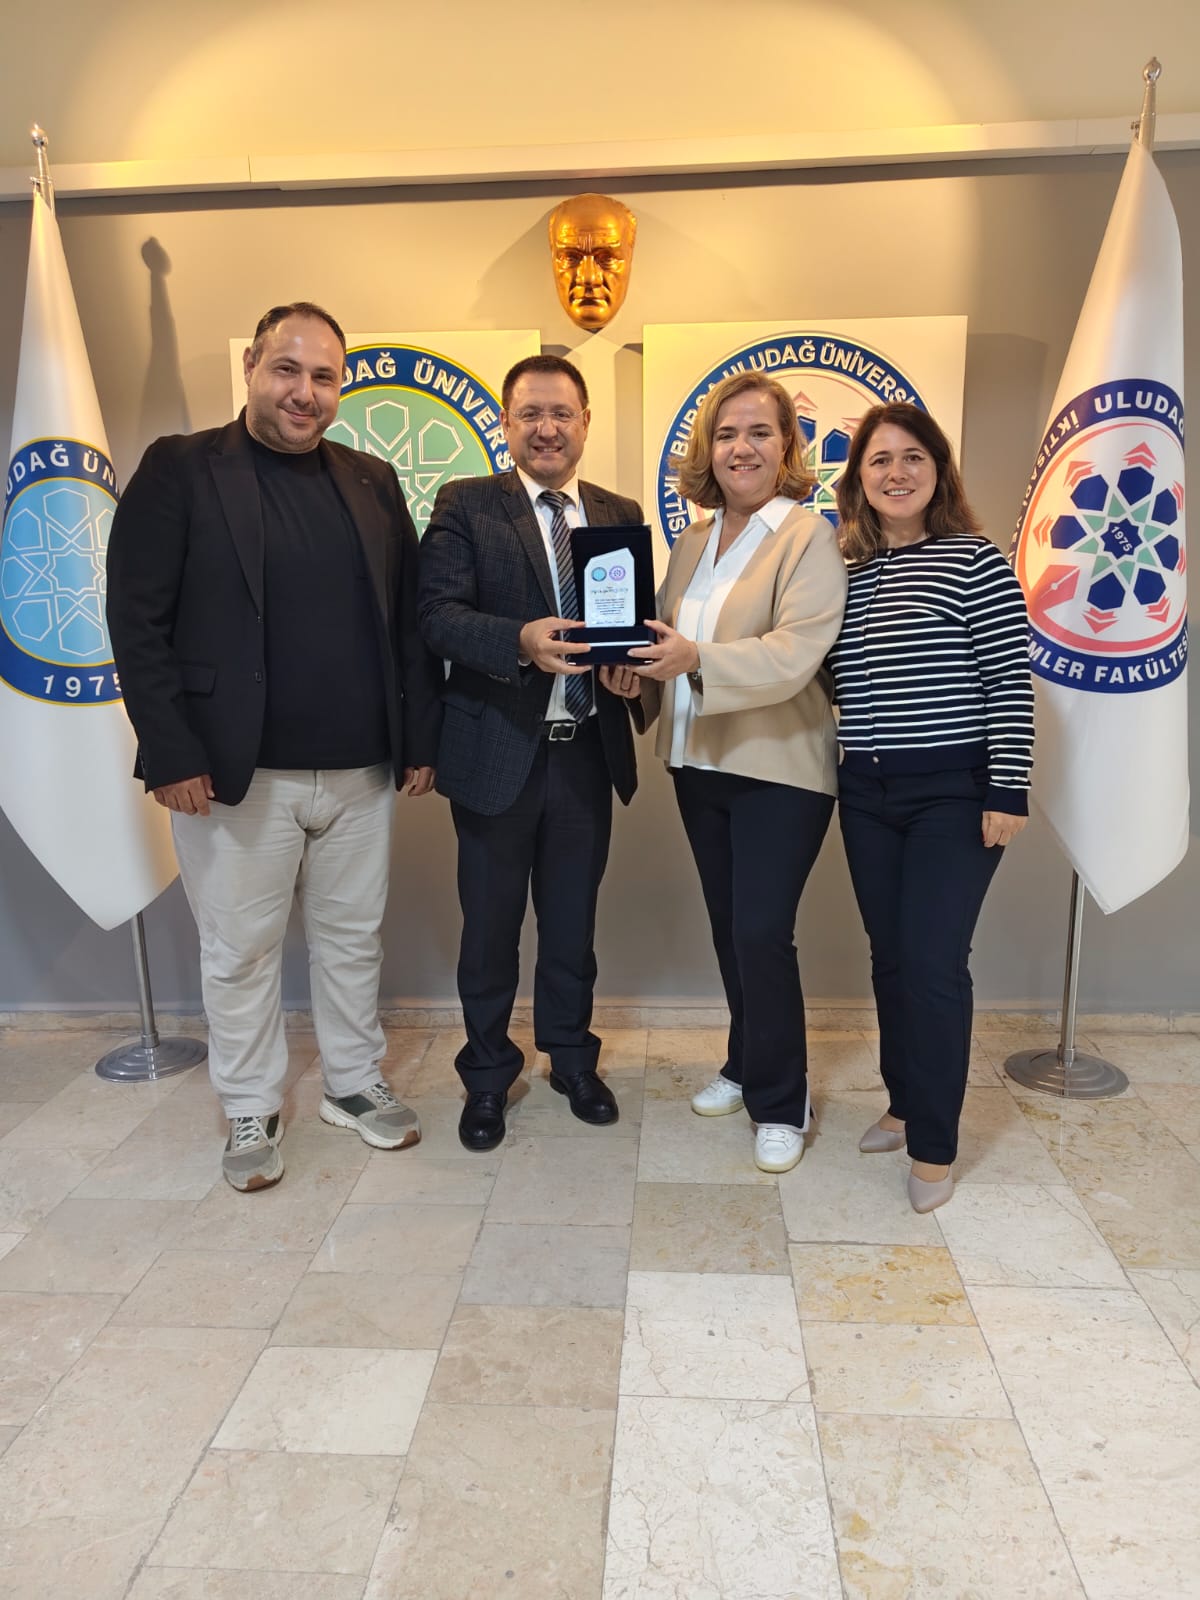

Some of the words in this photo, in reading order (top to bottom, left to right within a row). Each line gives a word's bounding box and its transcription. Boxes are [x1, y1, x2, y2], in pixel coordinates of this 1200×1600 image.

[5, 444, 70, 502] UDAĞ
[664, 475, 688, 538] İKTİS
[1111, 526, 1133, 552] 1975
[1028, 633, 1086, 680] MLER
